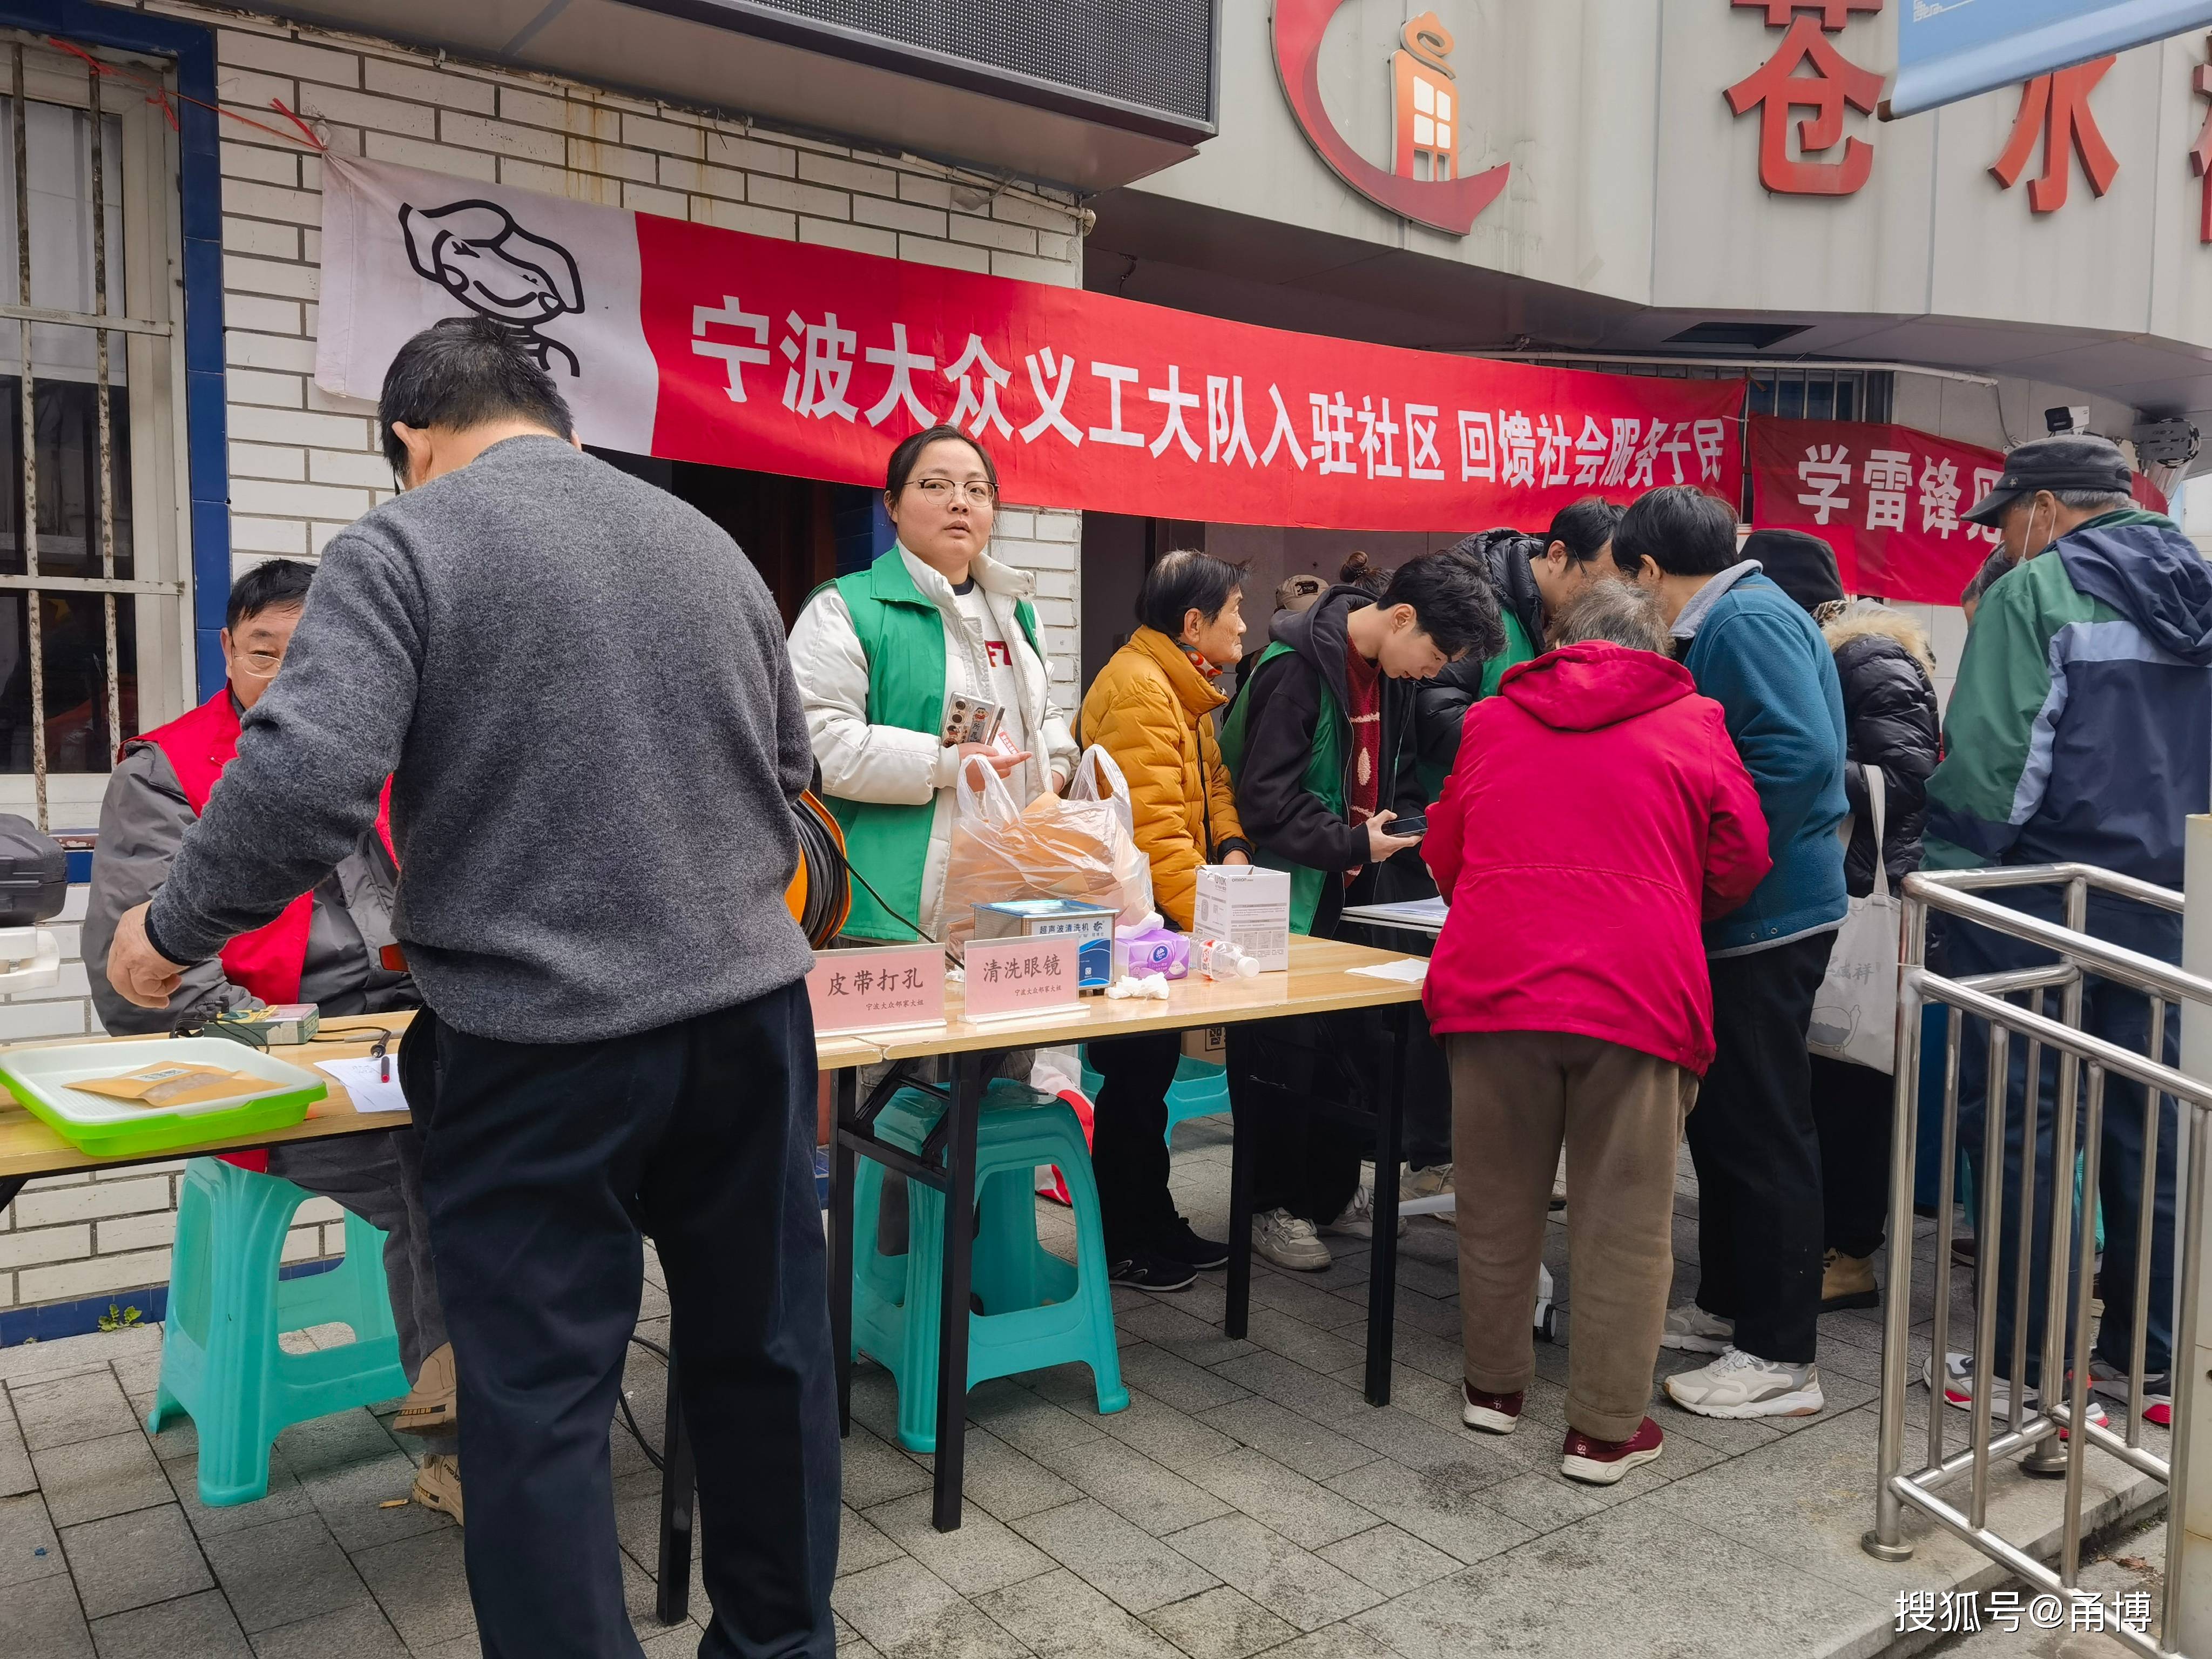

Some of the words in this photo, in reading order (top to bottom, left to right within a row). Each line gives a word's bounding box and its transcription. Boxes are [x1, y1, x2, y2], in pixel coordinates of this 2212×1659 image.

[691, 295, 1445, 481] 宁波大众义工大队入驻社区
[1039, 922, 1089, 934] 超声波清洗机
[827, 967, 923, 996] 皮带打孔
[983, 954, 1062, 983] 清洗眼镜
[866, 999, 925, 1011] 宁波大众邻家大姐
